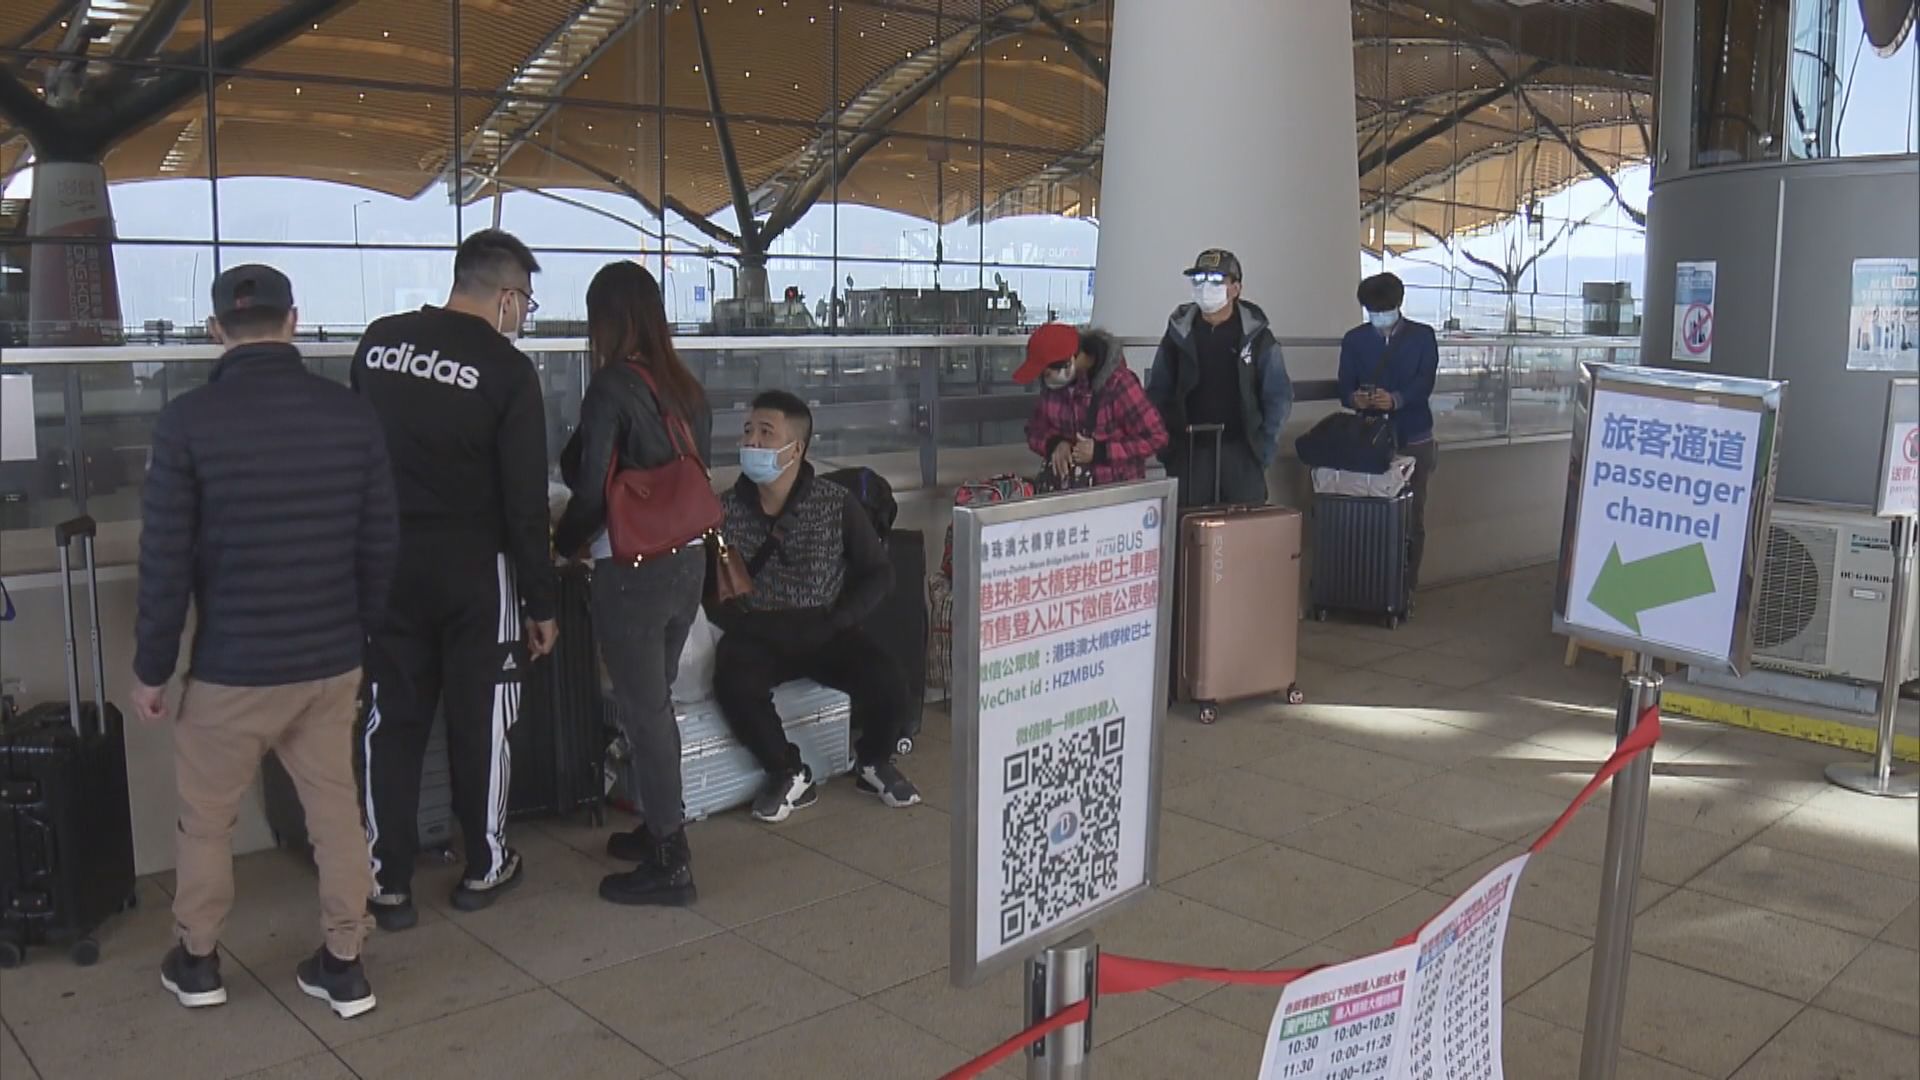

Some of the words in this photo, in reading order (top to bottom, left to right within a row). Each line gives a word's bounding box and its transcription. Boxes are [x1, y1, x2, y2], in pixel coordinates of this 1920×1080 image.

[366, 342, 480, 389] adidas
[1601, 412, 1746, 471] 旅客通道
[1593, 460, 1745, 504] passenger
[1606, 496, 1720, 541] channel
[1052, 660, 1105, 690] HZMBUS
[1283, 1058, 1315, 1079] 11:30
[1330, 1033, 1393, 1065] 10:00~11:28
[1287, 1035, 1320, 1056] 10:30
[1334, 1011, 1396, 1043] 10:00~10:28
